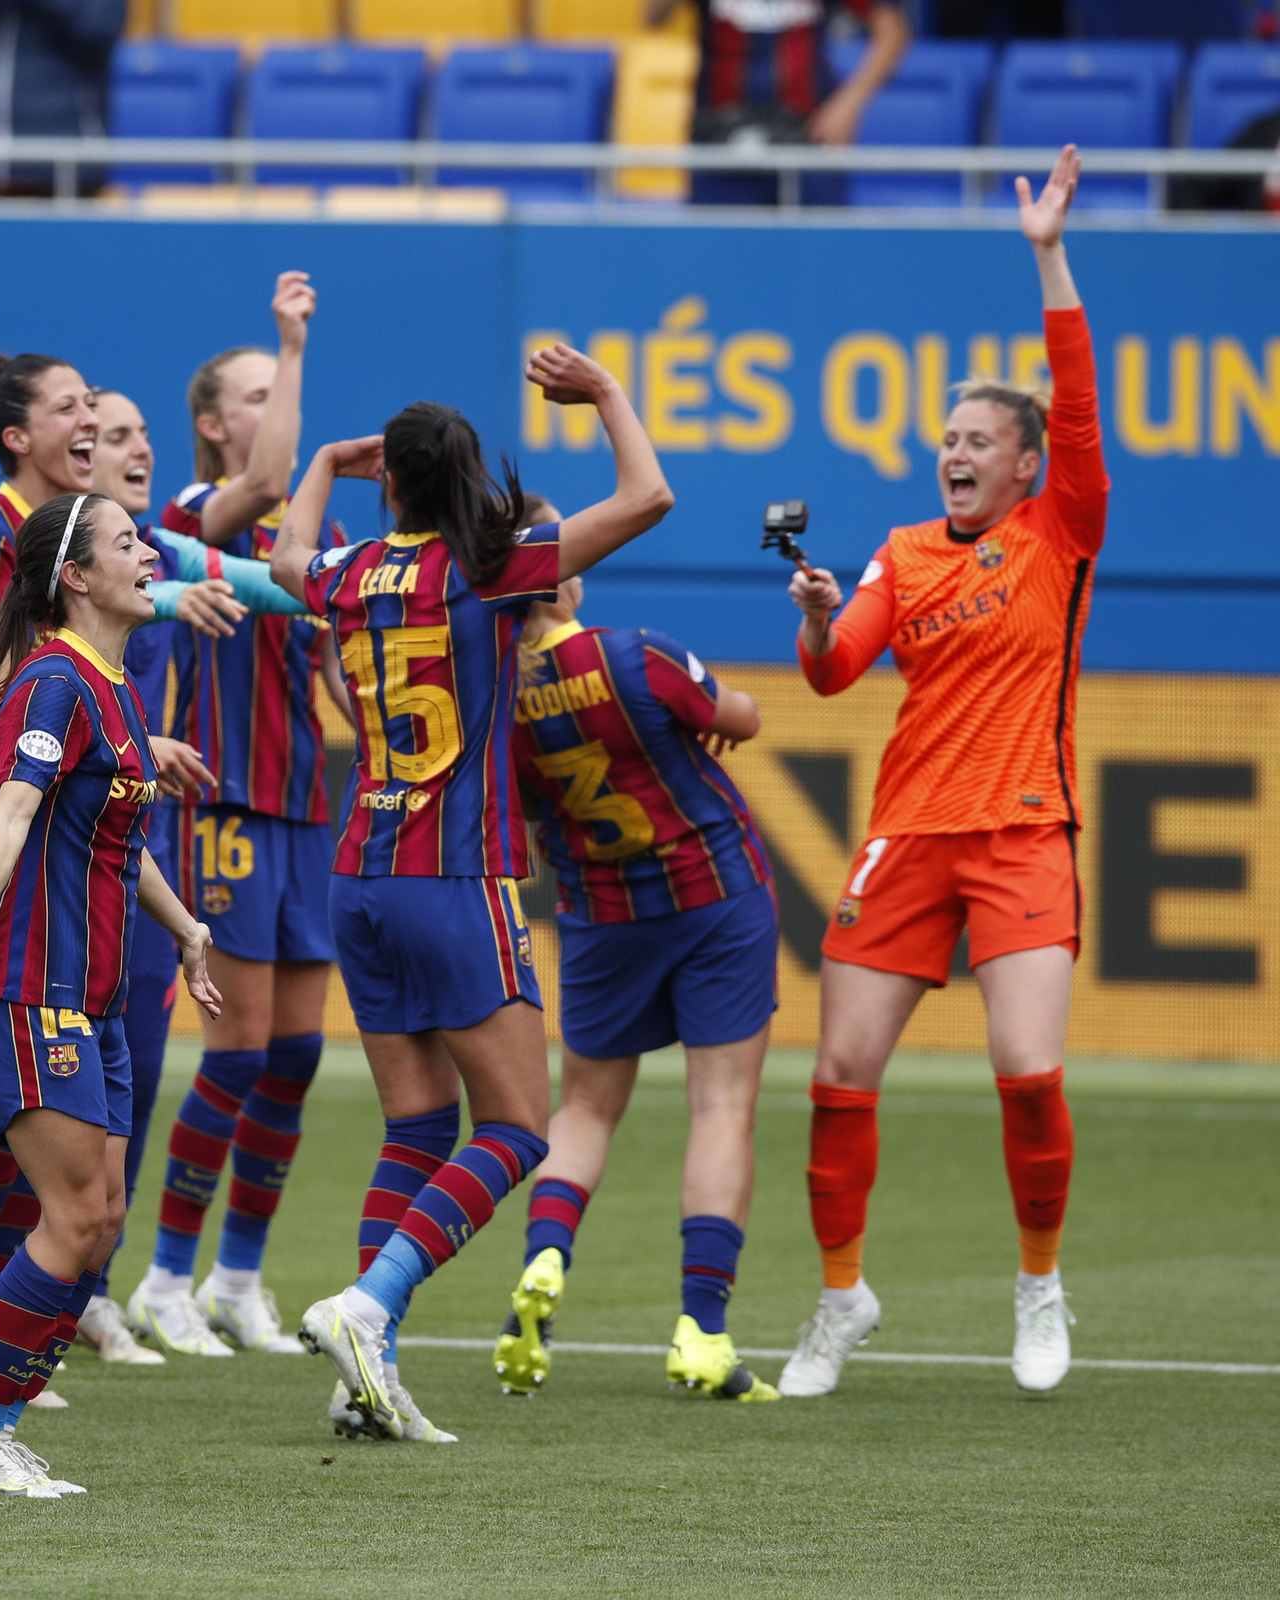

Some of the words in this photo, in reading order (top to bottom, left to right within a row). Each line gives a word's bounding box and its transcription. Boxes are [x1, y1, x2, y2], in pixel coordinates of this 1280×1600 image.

[522, 297, 793, 452] MÉS
[357, 563, 420, 599] LEILA
[340, 624, 463, 783] 15
[531, 738, 655, 861] 3
[194, 815, 254, 881] 16
[848, 837, 889, 896] 1
[39, 1007, 94, 1039] 14
